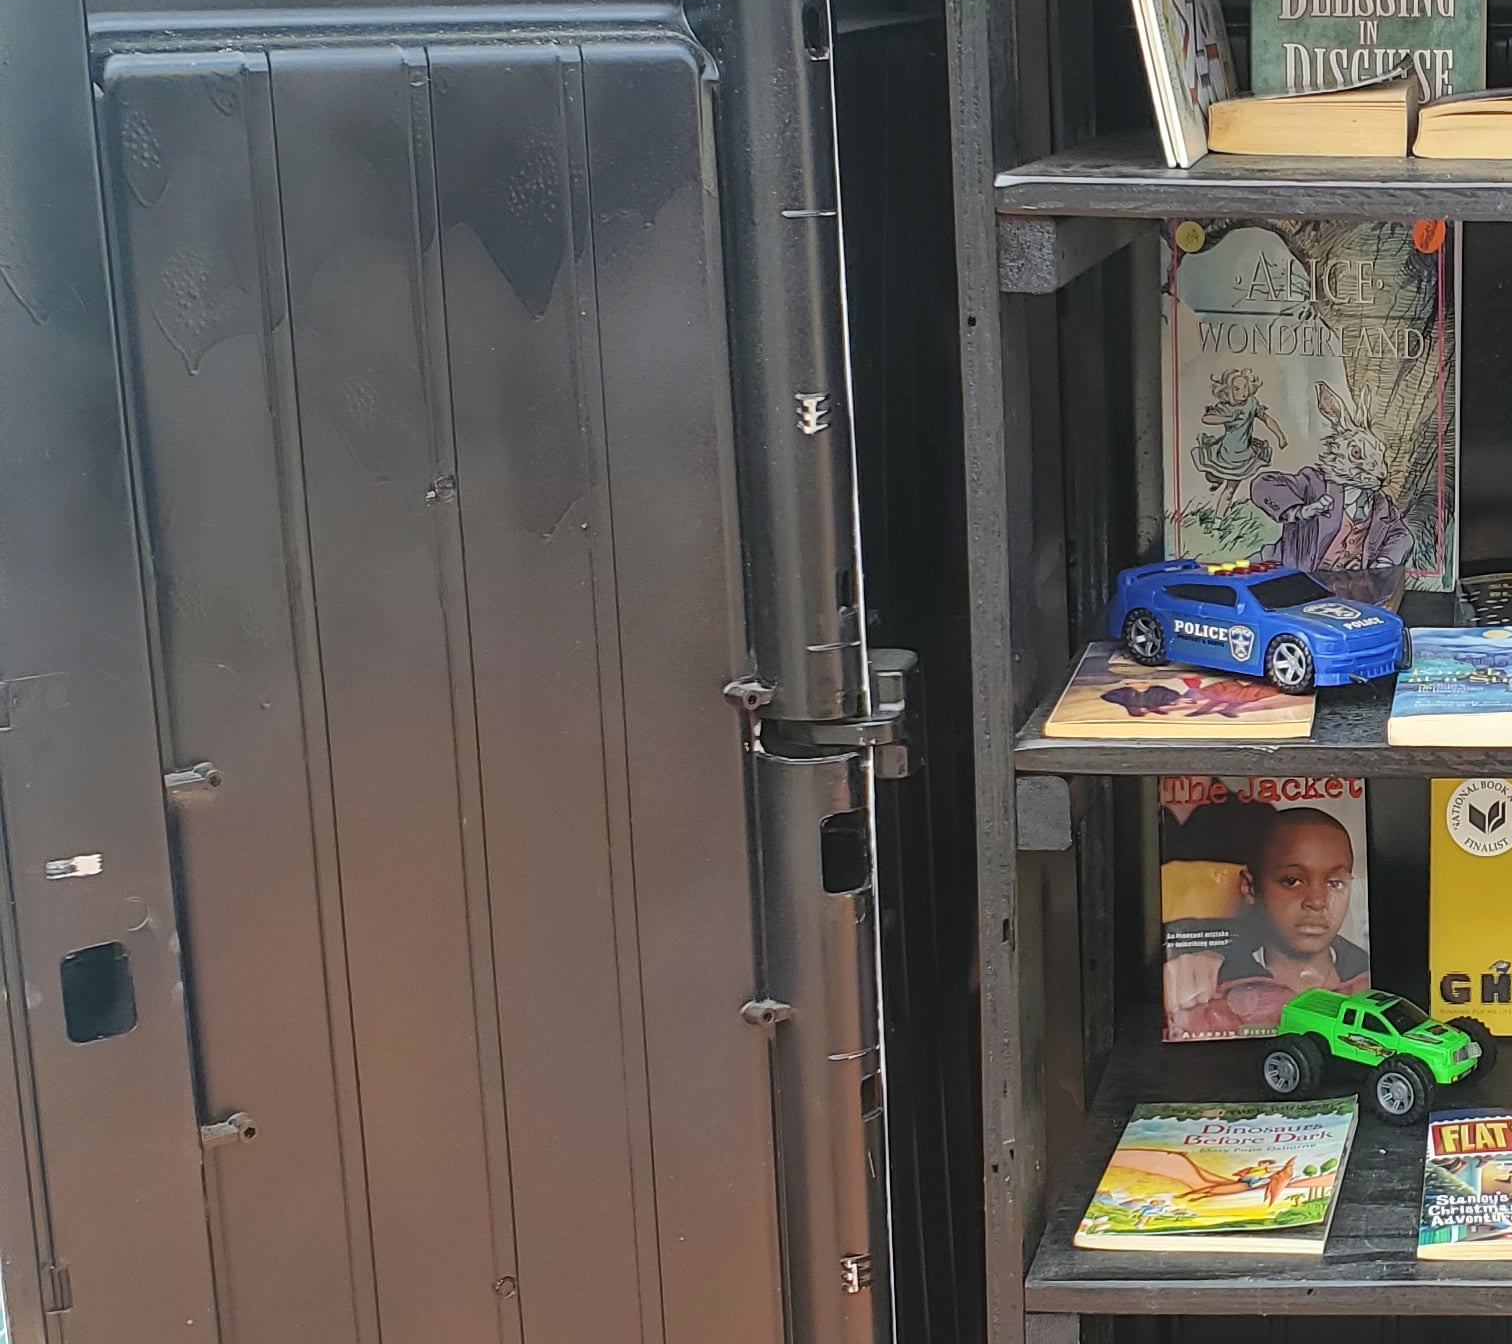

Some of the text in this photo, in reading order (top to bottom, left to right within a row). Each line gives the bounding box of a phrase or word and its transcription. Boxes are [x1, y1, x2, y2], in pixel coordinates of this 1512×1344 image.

[1359, 20, 1378, 45] IN
[1246, 251, 1377, 303] ALICE
[1198, 320, 1425, 359] WONDERLAND
[1174, 619, 1228, 641] POLICE
[1343, 617, 1385, 631] POLICE
[1163, 776, 1362, 804] The Jacket
[1480, 781, 1510, 795] BOOK
[1464, 837, 1509, 852] FINALIST
[1201, 1122, 1323, 1134] Dinosaurs
[1440, 1119, 1512, 1153] FLAT
[1183, 1131, 1333, 1145] Before Dark
[1436, 1191, 1509, 1206] Stanley's
